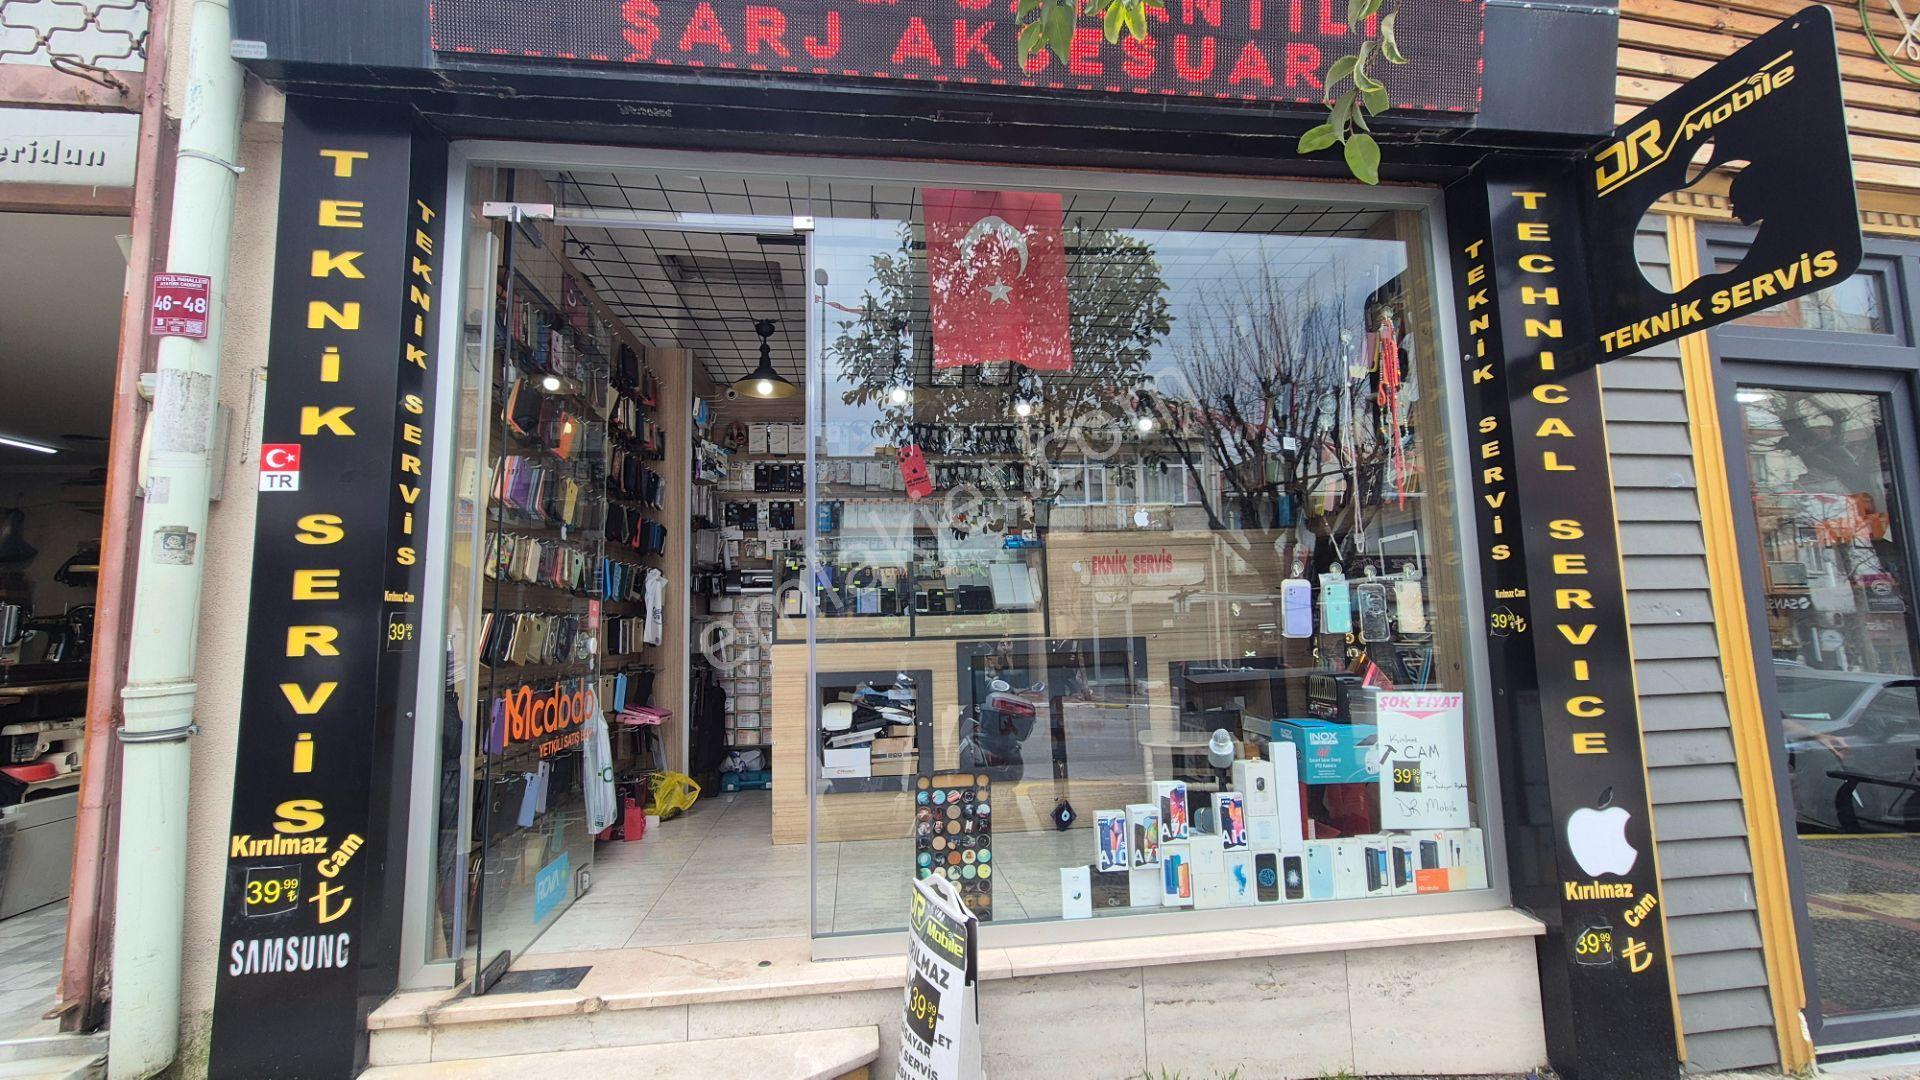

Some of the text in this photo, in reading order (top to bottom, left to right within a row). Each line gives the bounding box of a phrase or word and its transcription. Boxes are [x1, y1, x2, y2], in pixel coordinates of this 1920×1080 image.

[620, 0, 842, 61] ŞARJ
[1595, 65, 1796, 190] DR Mobile
[154, 295, 206, 314] 46-48
[1600, 250, 1838, 353] TEKNİK SERVİS
[396, 200, 435, 566] TEKNİK SERVİS
[1465, 240, 1510, 560] TEKNİK SERVİS
[265, 474, 292, 488] TR
[273, 149, 369, 833] TEKNİK SERVİS
[1512, 192, 1609, 754] TECHNICAL SERVICE
[1133, 548, 1172, 574] SERVİS
[504, 678, 595, 747] Mcdodo
[1380, 696, 1410, 711] ŞOK
[1403, 744, 1440, 759] CAM
[231, 834, 328, 858] Kırılmaz
[1565, 881, 1634, 901] Kırılmaz
[230, 932, 350, 977] SAMSUNG
[927, 920, 964, 958] Mobile
